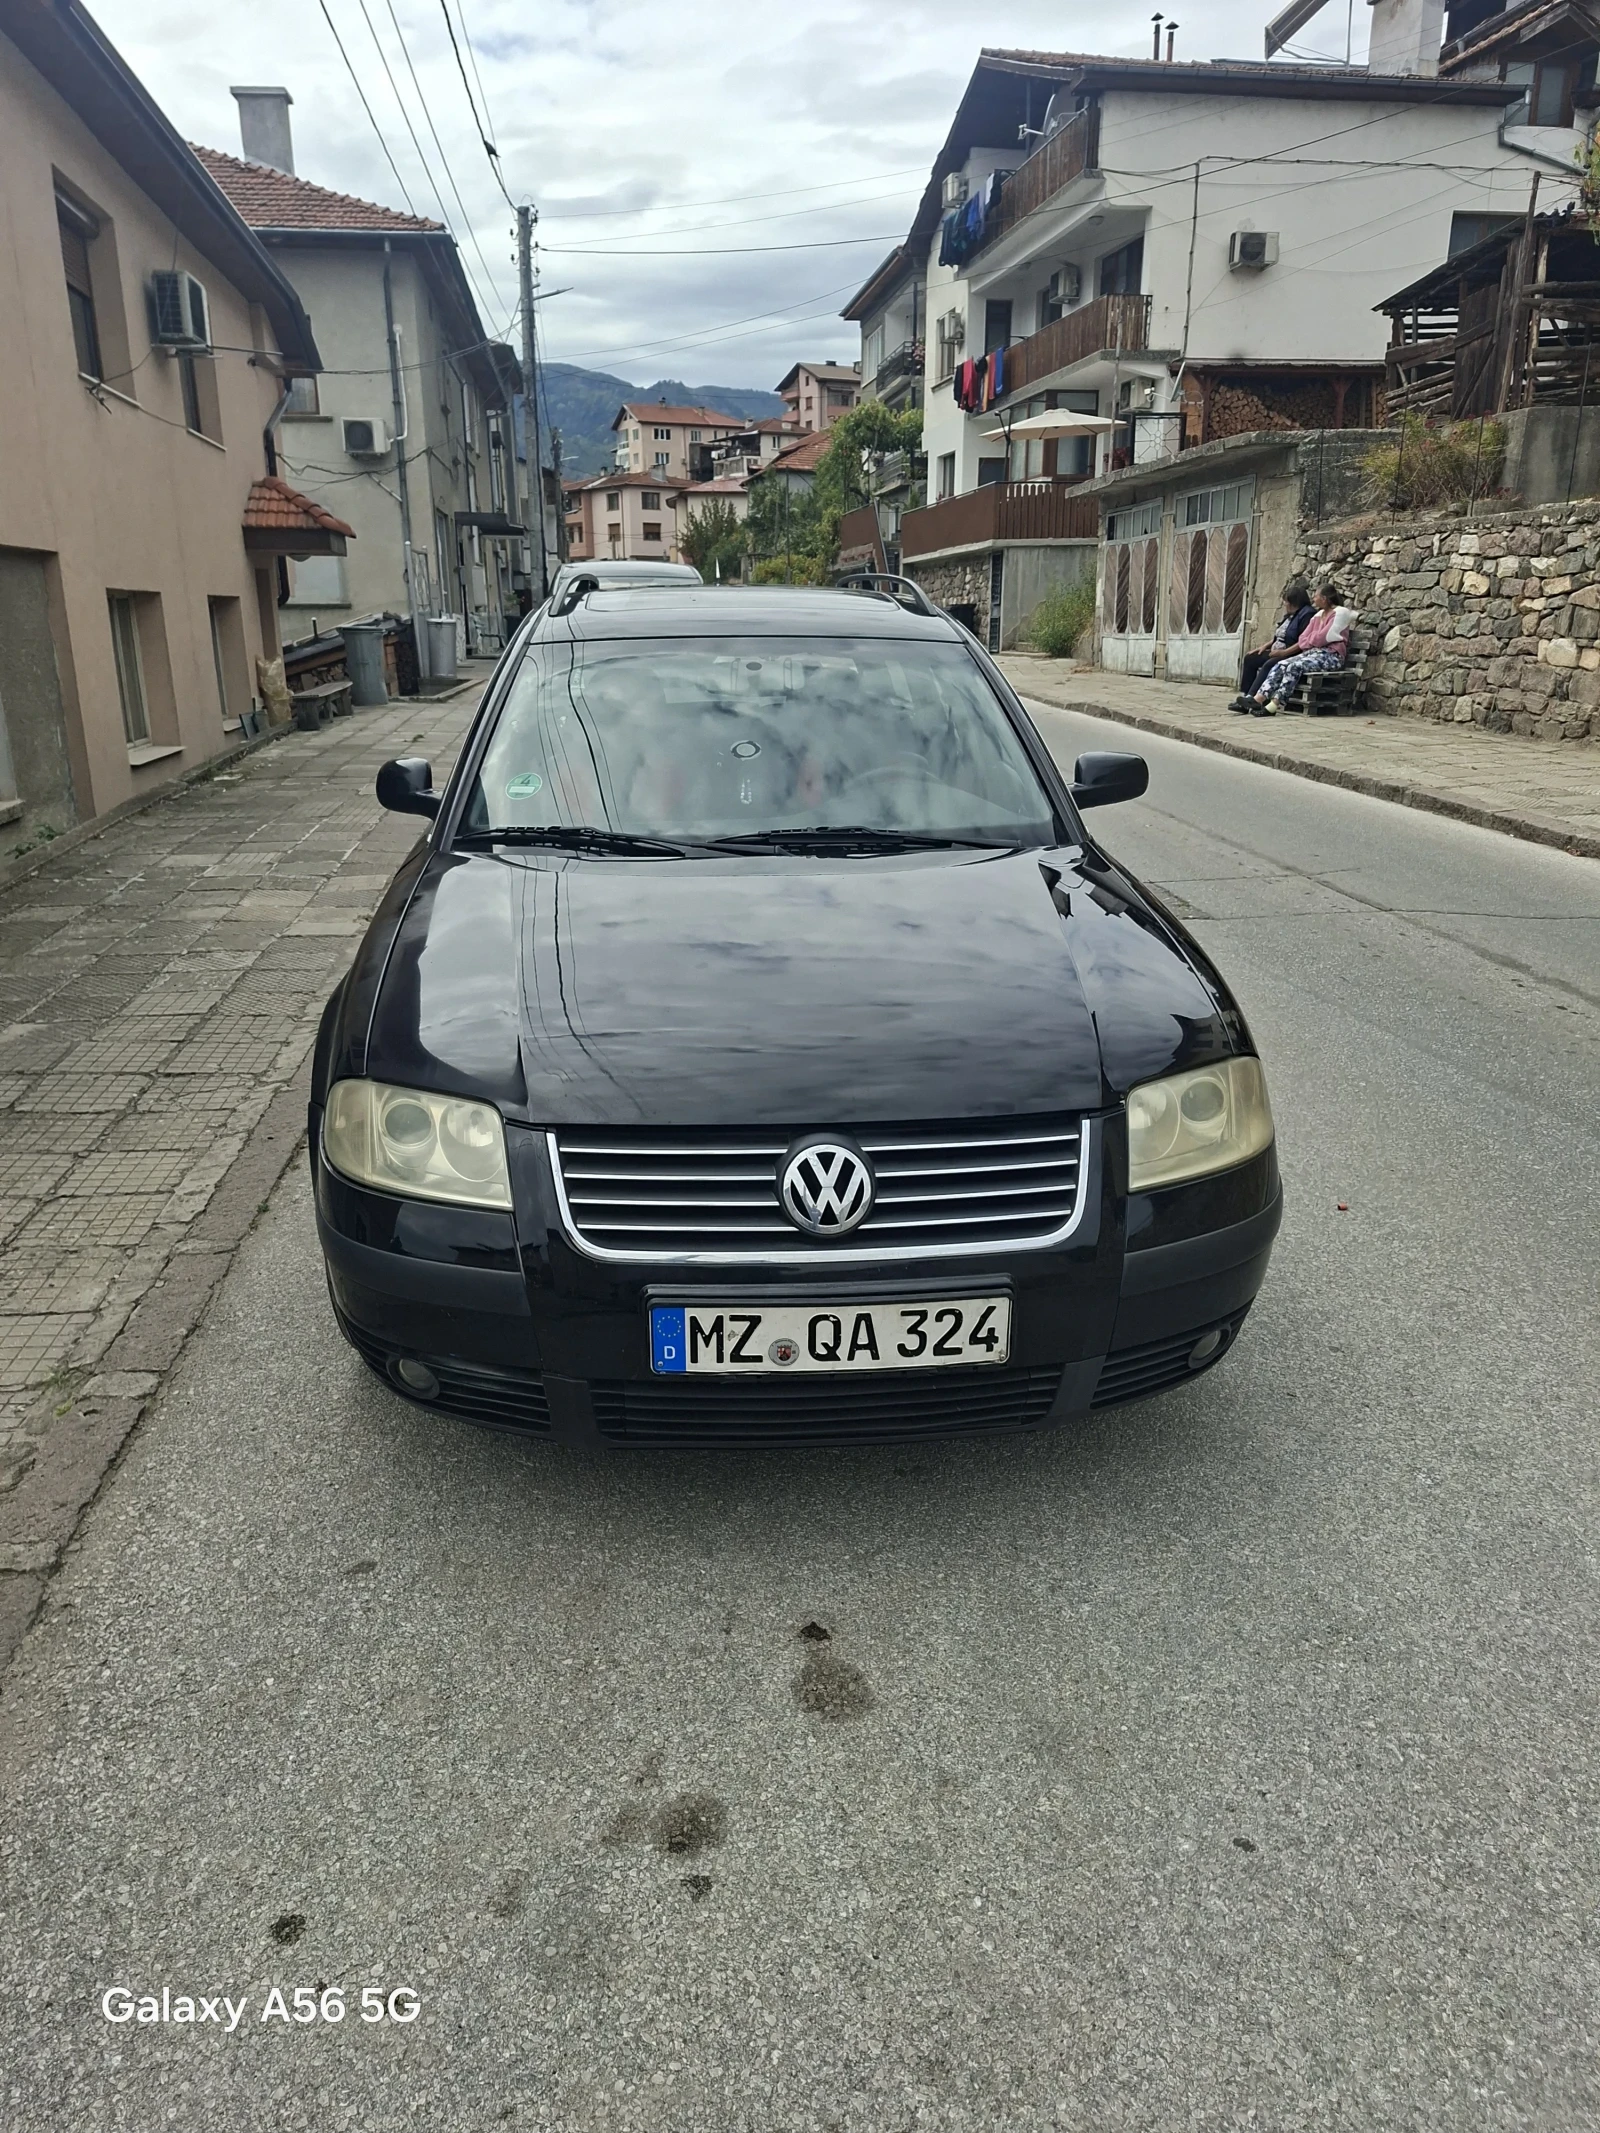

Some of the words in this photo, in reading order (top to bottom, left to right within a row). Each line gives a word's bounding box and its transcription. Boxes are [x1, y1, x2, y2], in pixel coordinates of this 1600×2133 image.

[520, 774, 532, 787] 4
[784, 1144, 872, 1235] VW
[663, 1345, 676, 1360] D
[689, 1314, 764, 1364] MZ
[807, 1312, 881, 1362] QA
[896, 1305, 999, 1358] 324
